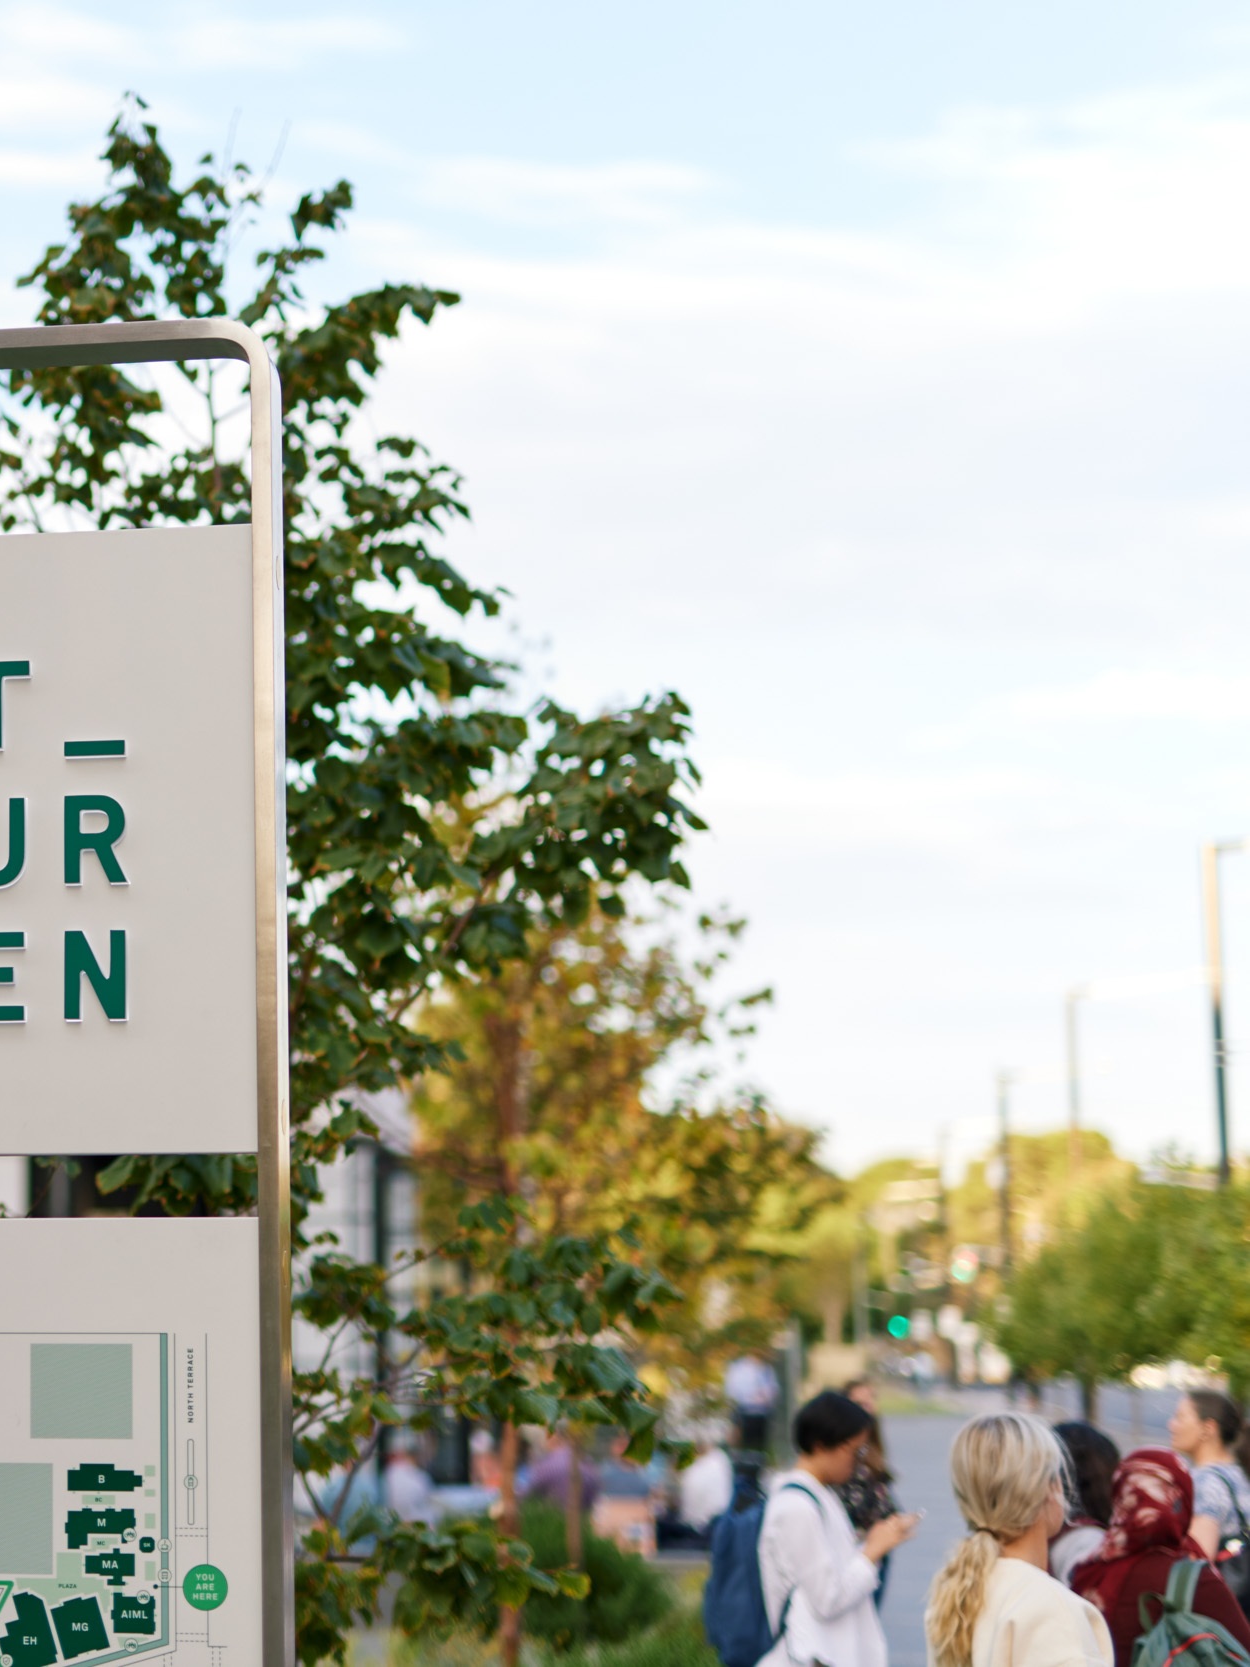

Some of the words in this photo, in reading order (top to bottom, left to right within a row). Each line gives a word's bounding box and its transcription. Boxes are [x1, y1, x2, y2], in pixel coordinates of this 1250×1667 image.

[98, 1475, 106, 1484] B
[97, 1518, 106, 1527] M
[102, 1560, 119, 1569] MA
[195, 1573, 215, 1582] YOU
[195, 1583, 215, 1592] ARE
[192, 1593, 218, 1601] HERE
[121, 1610, 148, 1620] AIML
[72, 1622, 89, 1632] MG
[23, 1636, 37, 1645] EH
